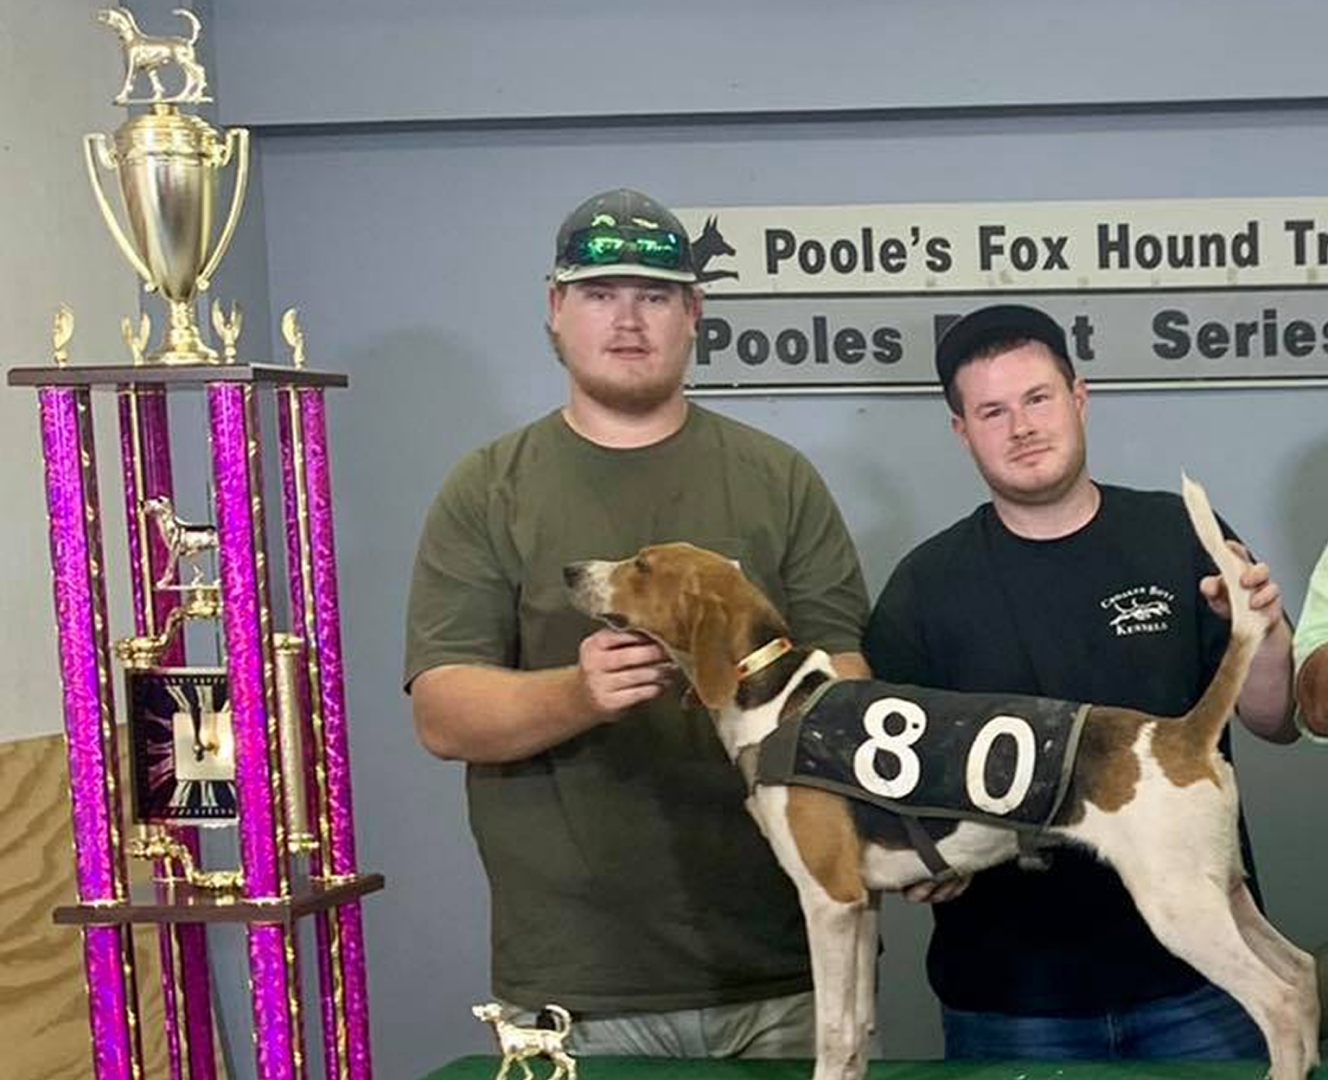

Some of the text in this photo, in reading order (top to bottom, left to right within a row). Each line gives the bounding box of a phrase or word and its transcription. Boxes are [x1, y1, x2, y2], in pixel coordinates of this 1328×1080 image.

[765, 226, 952, 275] Poole's
[978, 224, 1069, 271] Fox
[1097, 220, 1258, 269] Hound
[697, 314, 902, 366] Pooles
[854, 697, 1036, 815] 80
